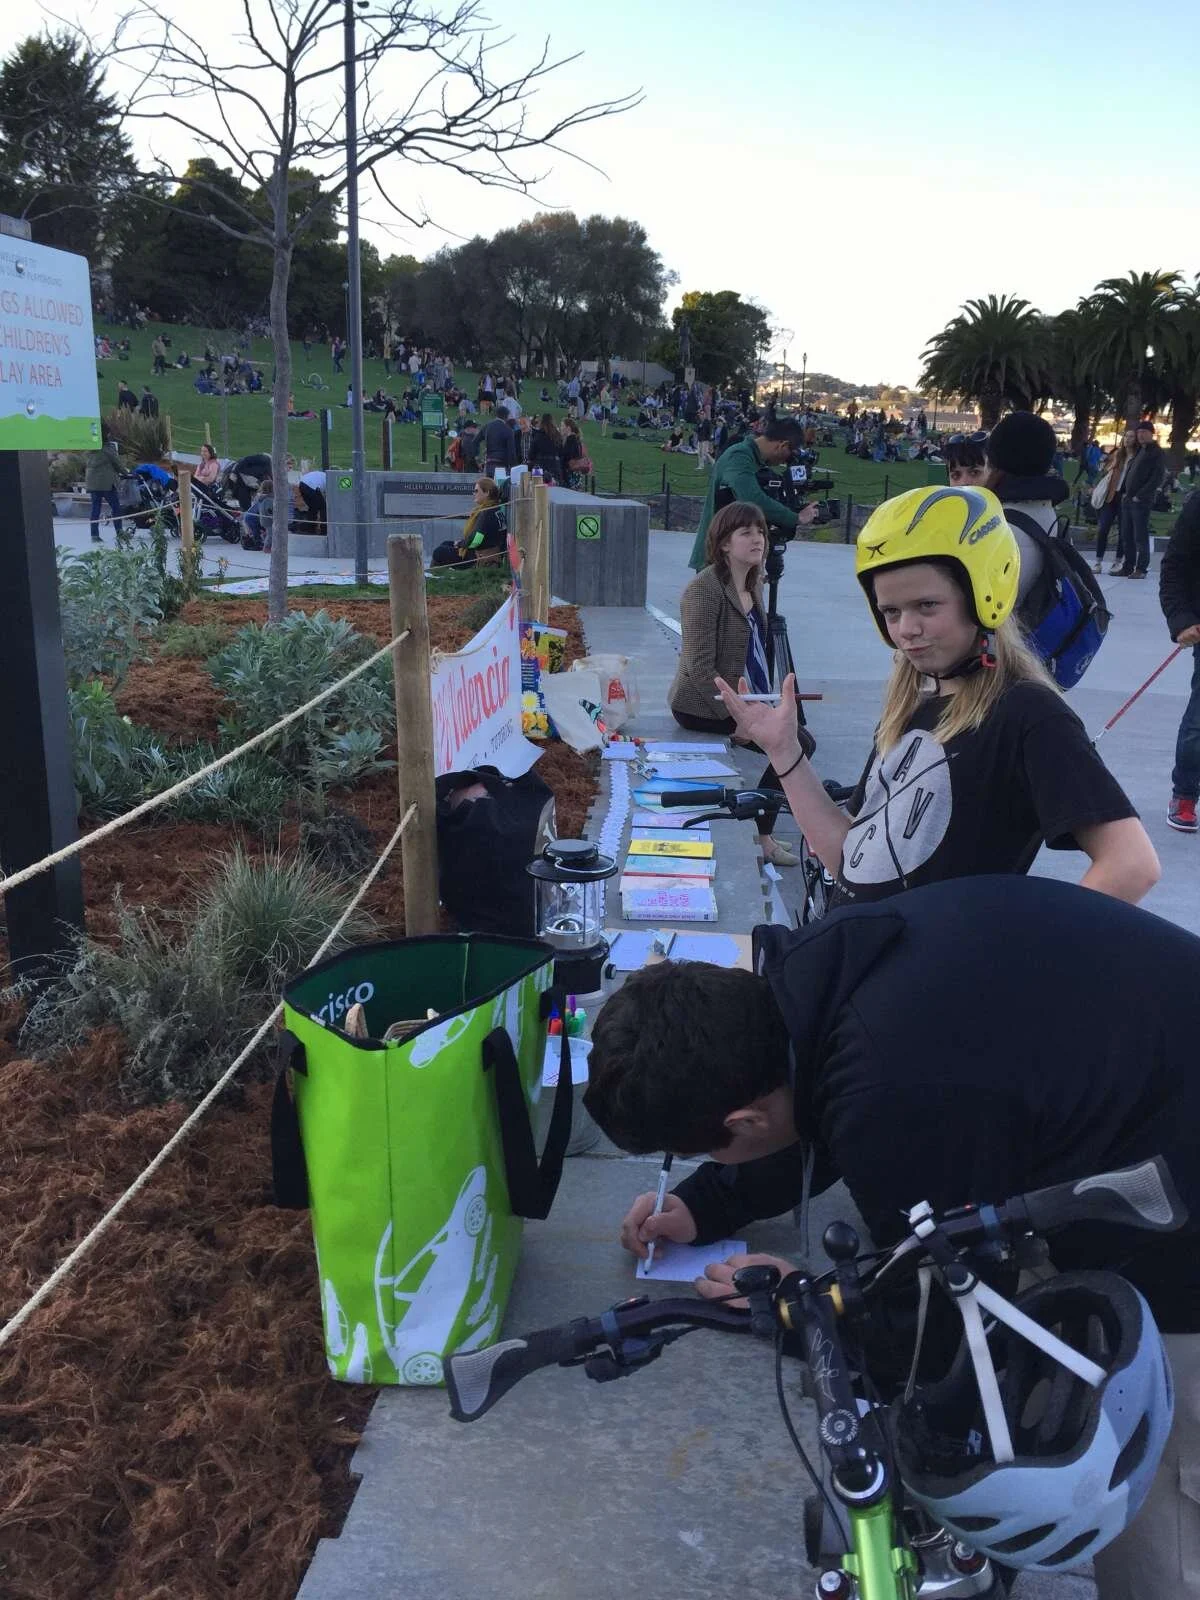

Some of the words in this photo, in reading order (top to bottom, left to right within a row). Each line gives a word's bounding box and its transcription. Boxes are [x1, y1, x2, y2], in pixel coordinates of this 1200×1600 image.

[24, 295, 84, 326] ALLOWED
[29, 363, 63, 388] AREA
[892, 736, 923, 783] A
[903, 787, 936, 839] V
